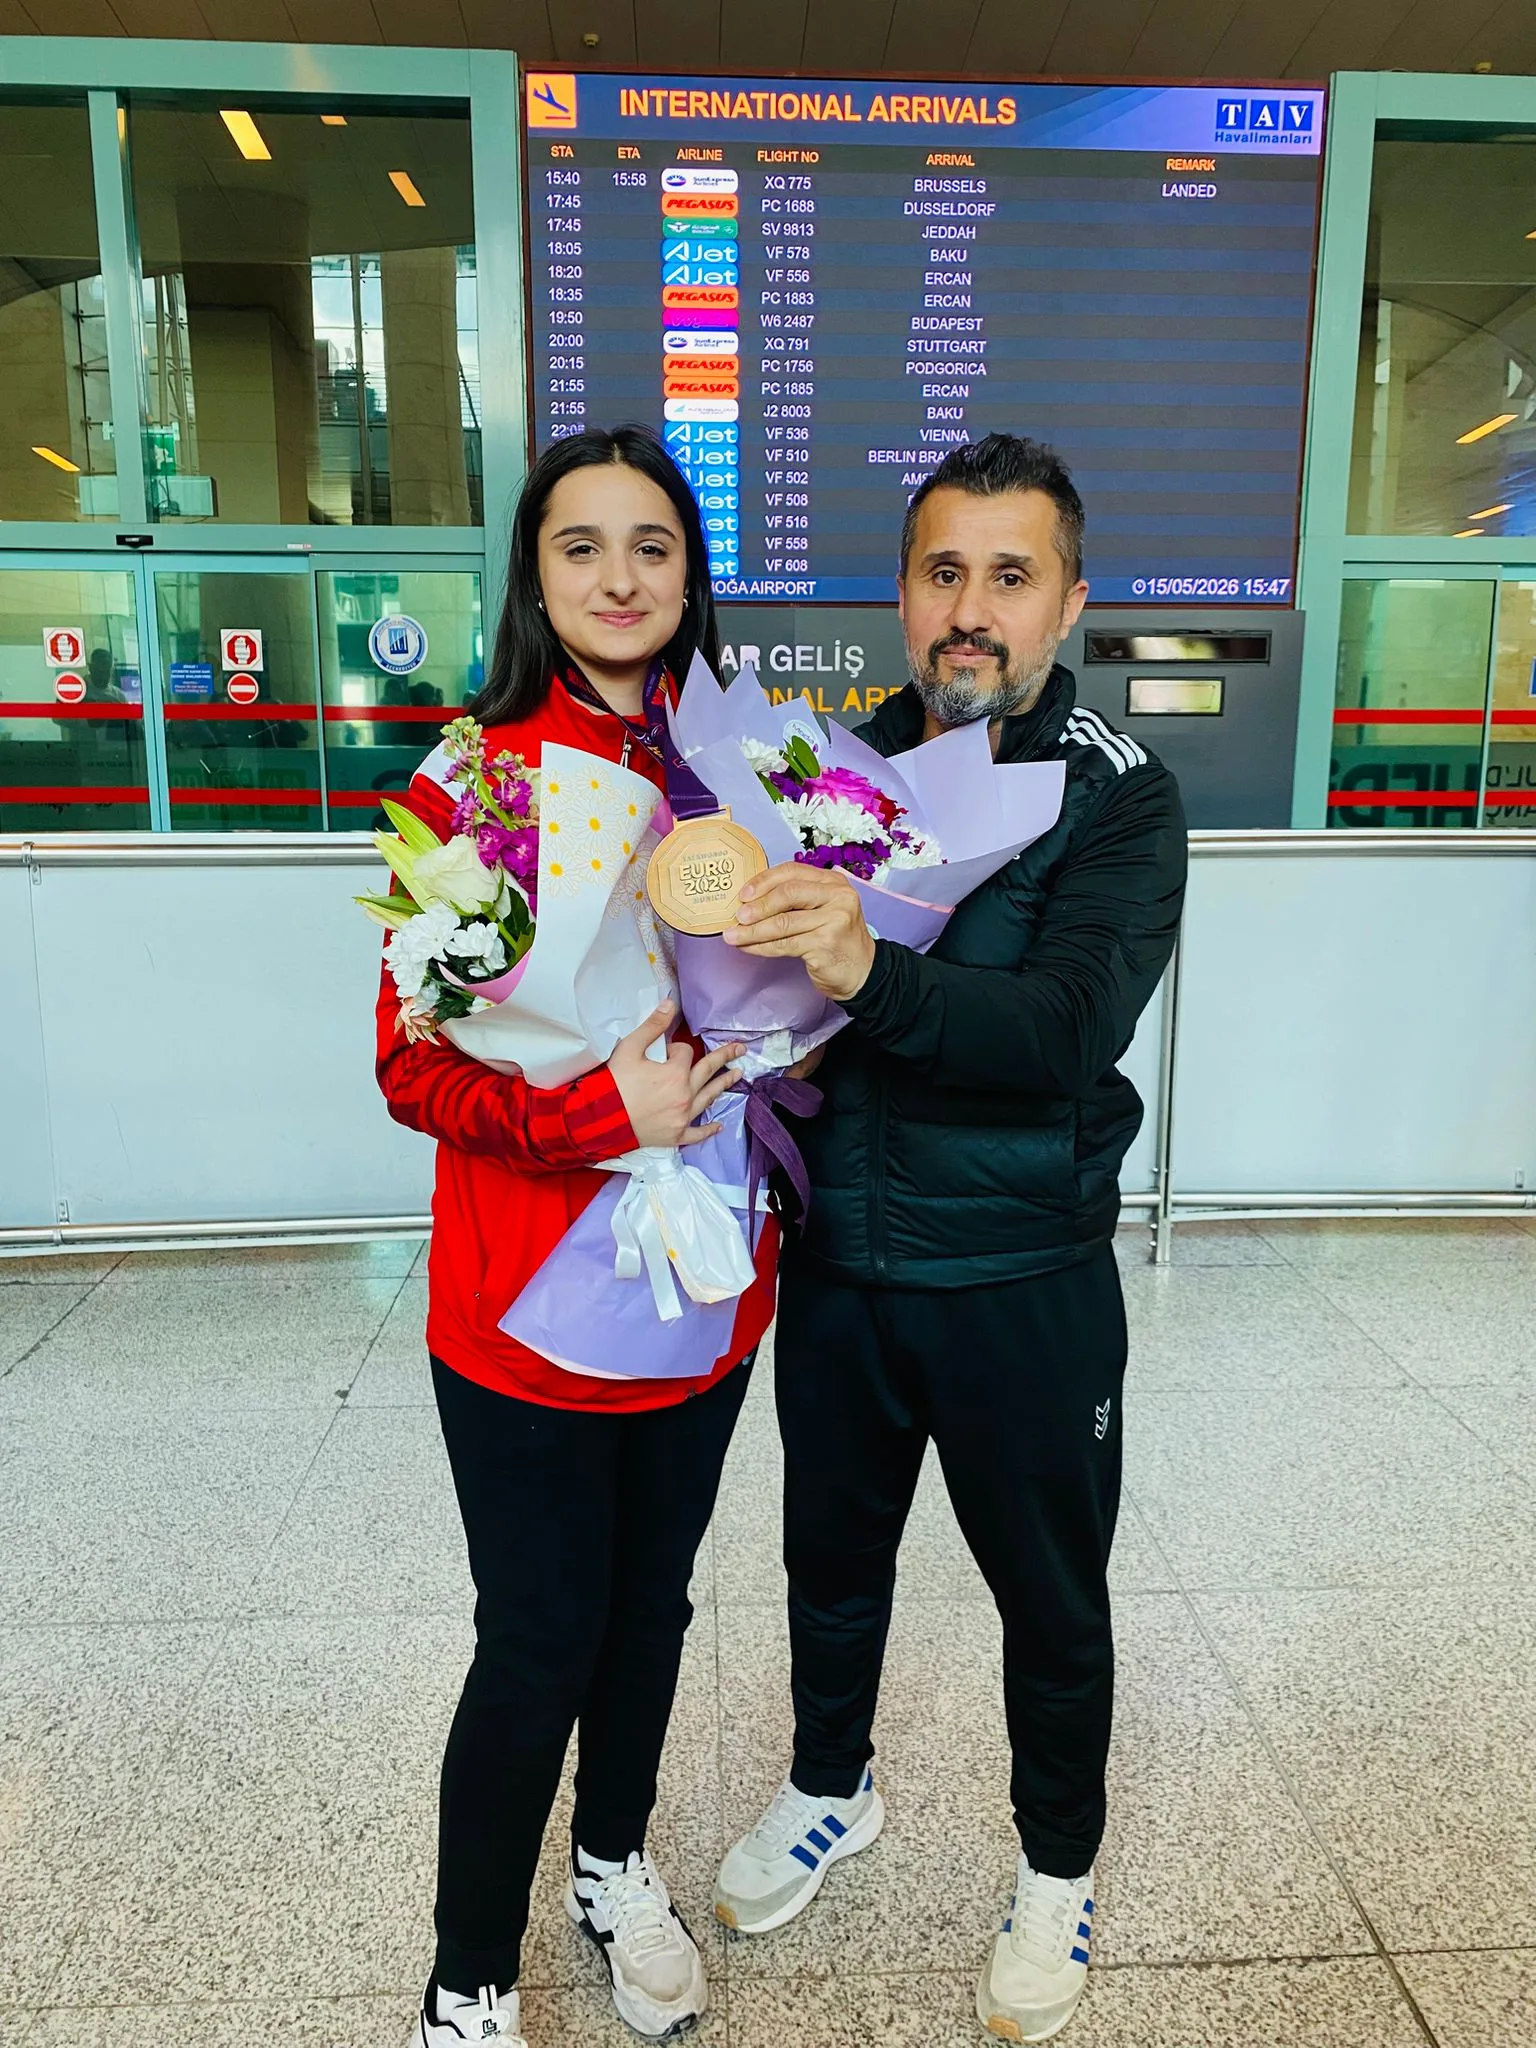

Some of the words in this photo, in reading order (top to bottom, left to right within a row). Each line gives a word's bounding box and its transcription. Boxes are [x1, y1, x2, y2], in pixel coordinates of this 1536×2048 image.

[619, 88, 861, 122] INTERNATIONAL
[866, 93, 1017, 126] ARRIVALS
[1214, 131, 1312, 144] Havalimanları
[551, 146, 573, 157] STA
[618, 147, 640, 158] ETA
[677, 149, 722, 160] AIRLINE
[758, 151, 799, 162] FLIGHT
[801, 152, 819, 162] NO
[926, 154, 975, 166] ARRIVAL
[1167, 159, 1215, 170] REMARK
[546, 171, 580, 184] 15:40
[613, 173, 646, 186] 15:58
[765, 176, 785, 189] XQ
[788, 177, 811, 189] 775
[915, 180, 986, 193] BRUSSELS
[1163, 184, 1216, 197] LANDED
[547, 195, 580, 208] 17:45
[666, 199, 735, 210] PEGASUS
[762, 200, 780, 212] PC
[785, 200, 814, 212] 1688
[904, 202, 995, 216] DUSSELDORF
[548, 218, 581, 231] 17:45
[762, 223, 780, 235] SV
[784, 223, 813, 236] 9813
[922, 226, 975, 239] JEDDAH
[548, 242, 581, 255] 18:05
[766, 246, 783, 258] VF
[787, 247, 809, 259] 578
[931, 250, 966, 261] BAKU
[549, 266, 582, 278] 18:20
[766, 270, 783, 281] VF
[787, 270, 809, 282] 556
[925, 272, 971, 285] ERCAN
[549, 288, 582, 300] 18:35
[667, 291, 735, 303] PEGASUS
[762, 292, 780, 304] PC
[785, 293, 813, 304] 1883
[925, 295, 970, 307] ERCAN
[550, 311, 582, 323] 19:50
[761, 315, 781, 327] W6
[785, 316, 814, 327] 2487
[912, 318, 983, 330] BUDAPEST
[550, 334, 583, 346] 20:00
[765, 338, 784, 350] XQ
[788, 338, 808, 350] 791
[907, 340, 986, 353] STUTTGART
[550, 357, 584, 369] 20:15
[668, 360, 736, 371] PEGASUS
[762, 360, 780, 372] PC
[784, 360, 813, 372] 1756
[906, 362, 986, 375] PODGORICA
[551, 379, 584, 391] 21:55
[668, 382, 736, 393] PEGASUS
[762, 383, 780, 394] PC
[784, 383, 813, 394] 1885
[923, 385, 968, 397] ERCAN
[551, 402, 584, 414] 21:55
[763, 405, 778, 417] J2
[781, 405, 811, 417] 8003
[928, 407, 963, 419] BAKU
[766, 428, 783, 439] VF
[786, 428, 808, 439] 536
[920, 429, 969, 441] VIENNA
[766, 449, 783, 461] VF
[786, 450, 808, 461] 510
[869, 451, 915, 462] BERLIN
[918, 450, 950, 464] BRA
[766, 472, 782, 483] VF
[786, 472, 808, 484] 502
[766, 494, 783, 505] VF
[786, 494, 808, 506] 508
[765, 516, 782, 527] VF
[786, 516, 808, 528] 516
[765, 537, 782, 549] VF
[786, 538, 808, 549] 558
[765, 559, 782, 571] VF
[786, 560, 807, 571] 608
[749, 581, 817, 595] AIRPORT
[1148, 579, 1239, 595] 15/05/2026
[1244, 579, 1290, 595] 15:47
[769, 640, 864, 678] GELİŞ
[679, 858, 735, 881] EURO
[684, 874, 733, 896] 2026
